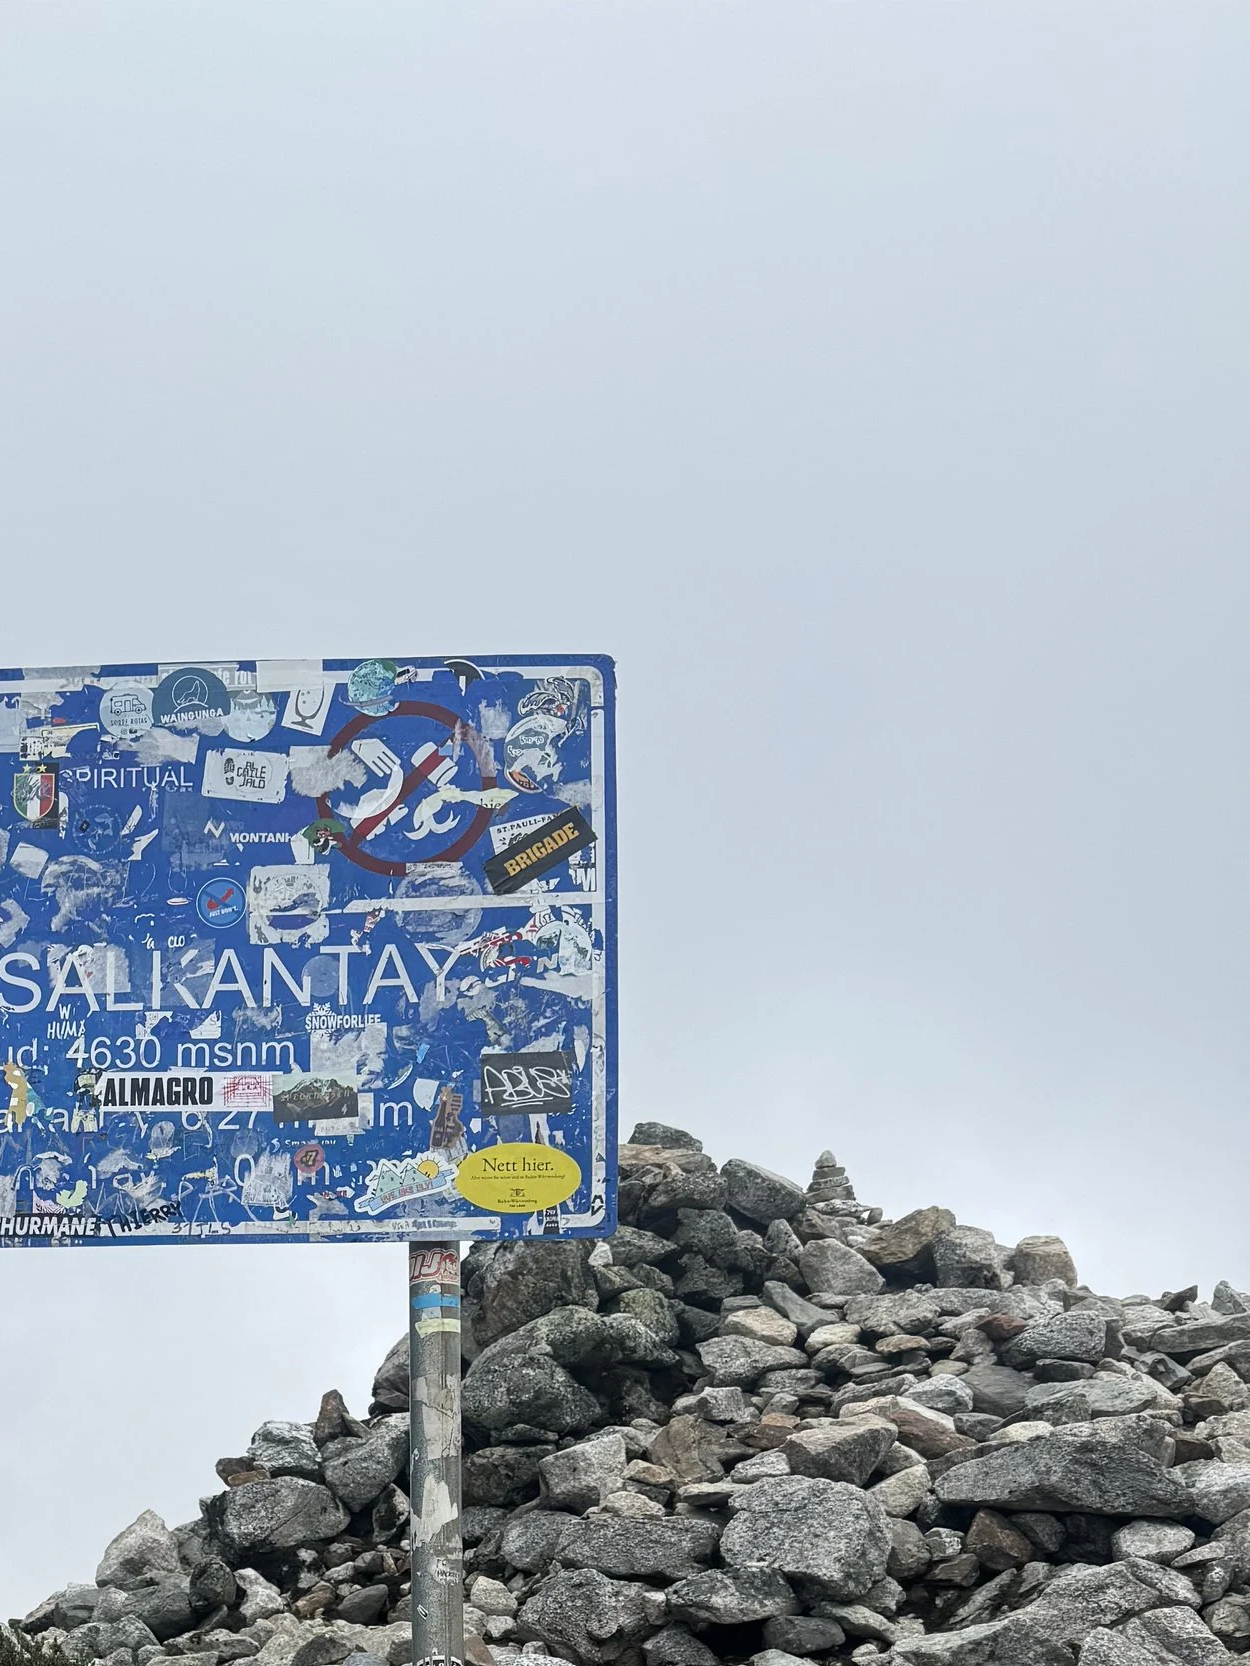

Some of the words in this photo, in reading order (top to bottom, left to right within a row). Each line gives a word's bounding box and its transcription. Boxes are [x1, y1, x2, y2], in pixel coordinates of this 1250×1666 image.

[503, 821, 580, 878] BRIGADE
[66, 1035, 161, 1069] 4630
[177, 1039, 295, 1069] msnm
[103, 1077, 214, 1107] ALMAGRO
[483, 1158, 517, 1172] Nett
[522, 1157, 554, 1171] hier.
